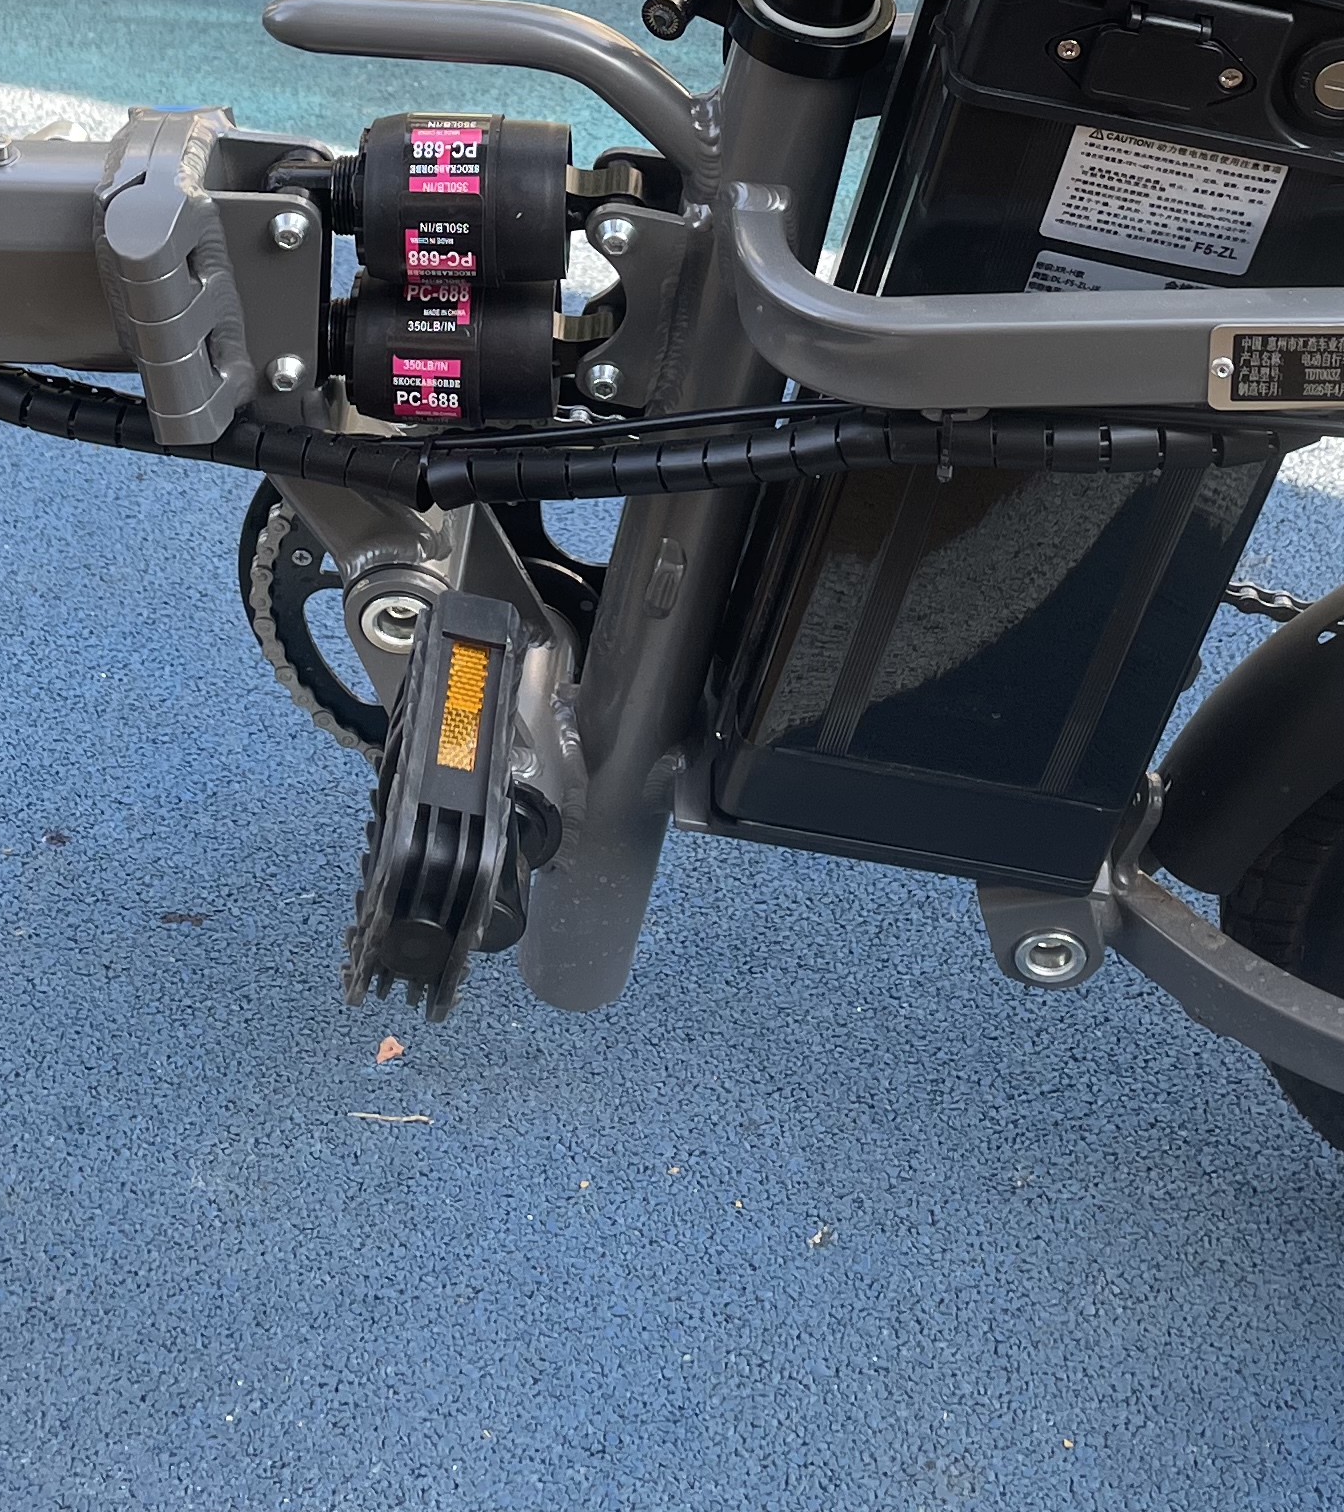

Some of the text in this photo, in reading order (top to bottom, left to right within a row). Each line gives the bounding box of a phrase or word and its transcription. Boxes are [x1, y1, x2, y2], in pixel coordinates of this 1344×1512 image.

[1106, 132, 1155, 150] CAUTION!
[412, 141, 478, 159] PC-688
[422, 181, 469, 192] 350LB/IN
[419, 222, 470, 233] 350LB/IN
[408, 251, 473, 267] PC-688
[1192, 241, 1238, 261] F5-ZL
[406, 285, 470, 302] PC-688
[407, 320, 456, 332] 350LB/IN
[403, 360, 448, 372] 350LB/IN
[396, 391, 459, 409] PC-688
